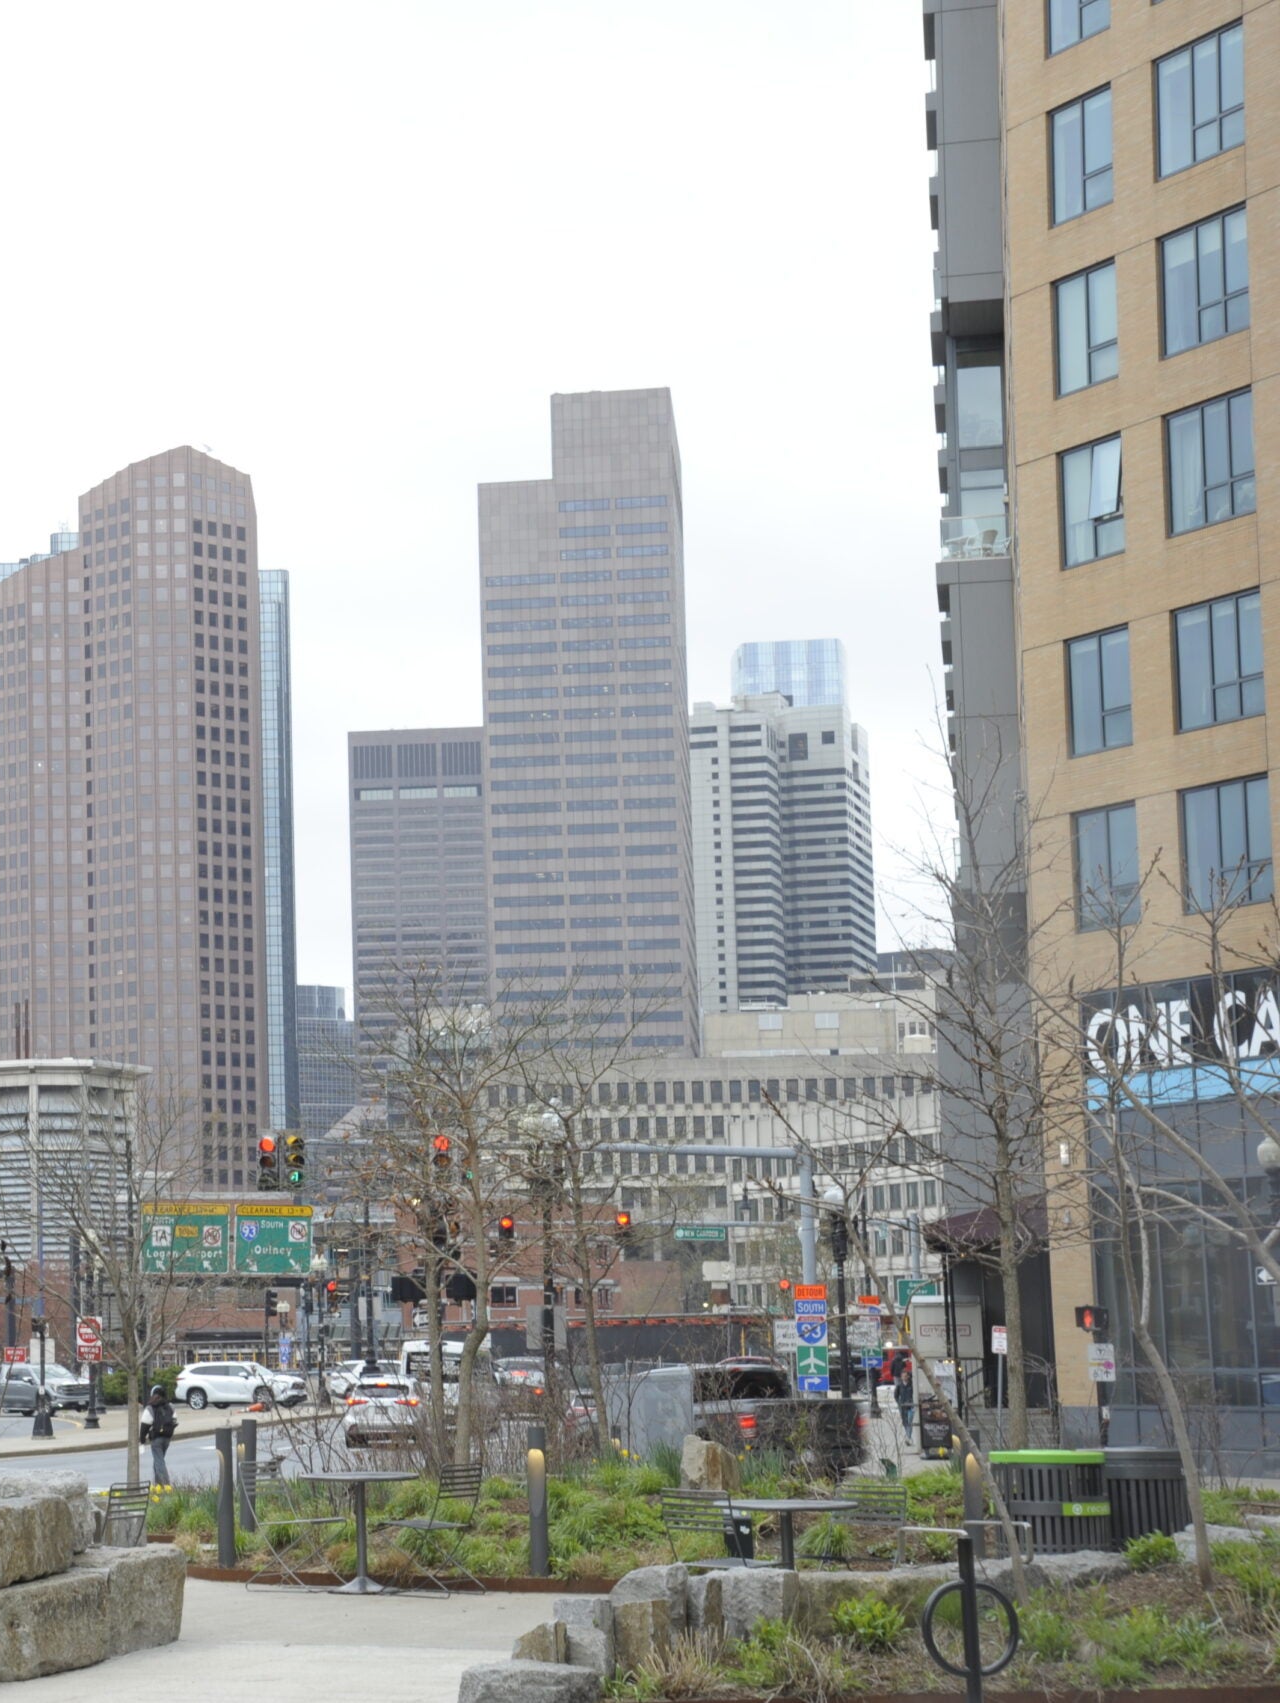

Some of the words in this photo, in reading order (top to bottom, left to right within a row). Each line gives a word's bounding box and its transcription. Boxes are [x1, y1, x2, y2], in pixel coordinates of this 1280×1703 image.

[1087, 1000, 1193, 1074] ONE
[261, 1220, 284, 1228] SOUTH
[242, 1225, 256, 1237] 93
[797, 1287, 823, 1296] DETOUR
[797, 1302, 824, 1313] SOUTH
[801, 1323, 821, 1338] 93
